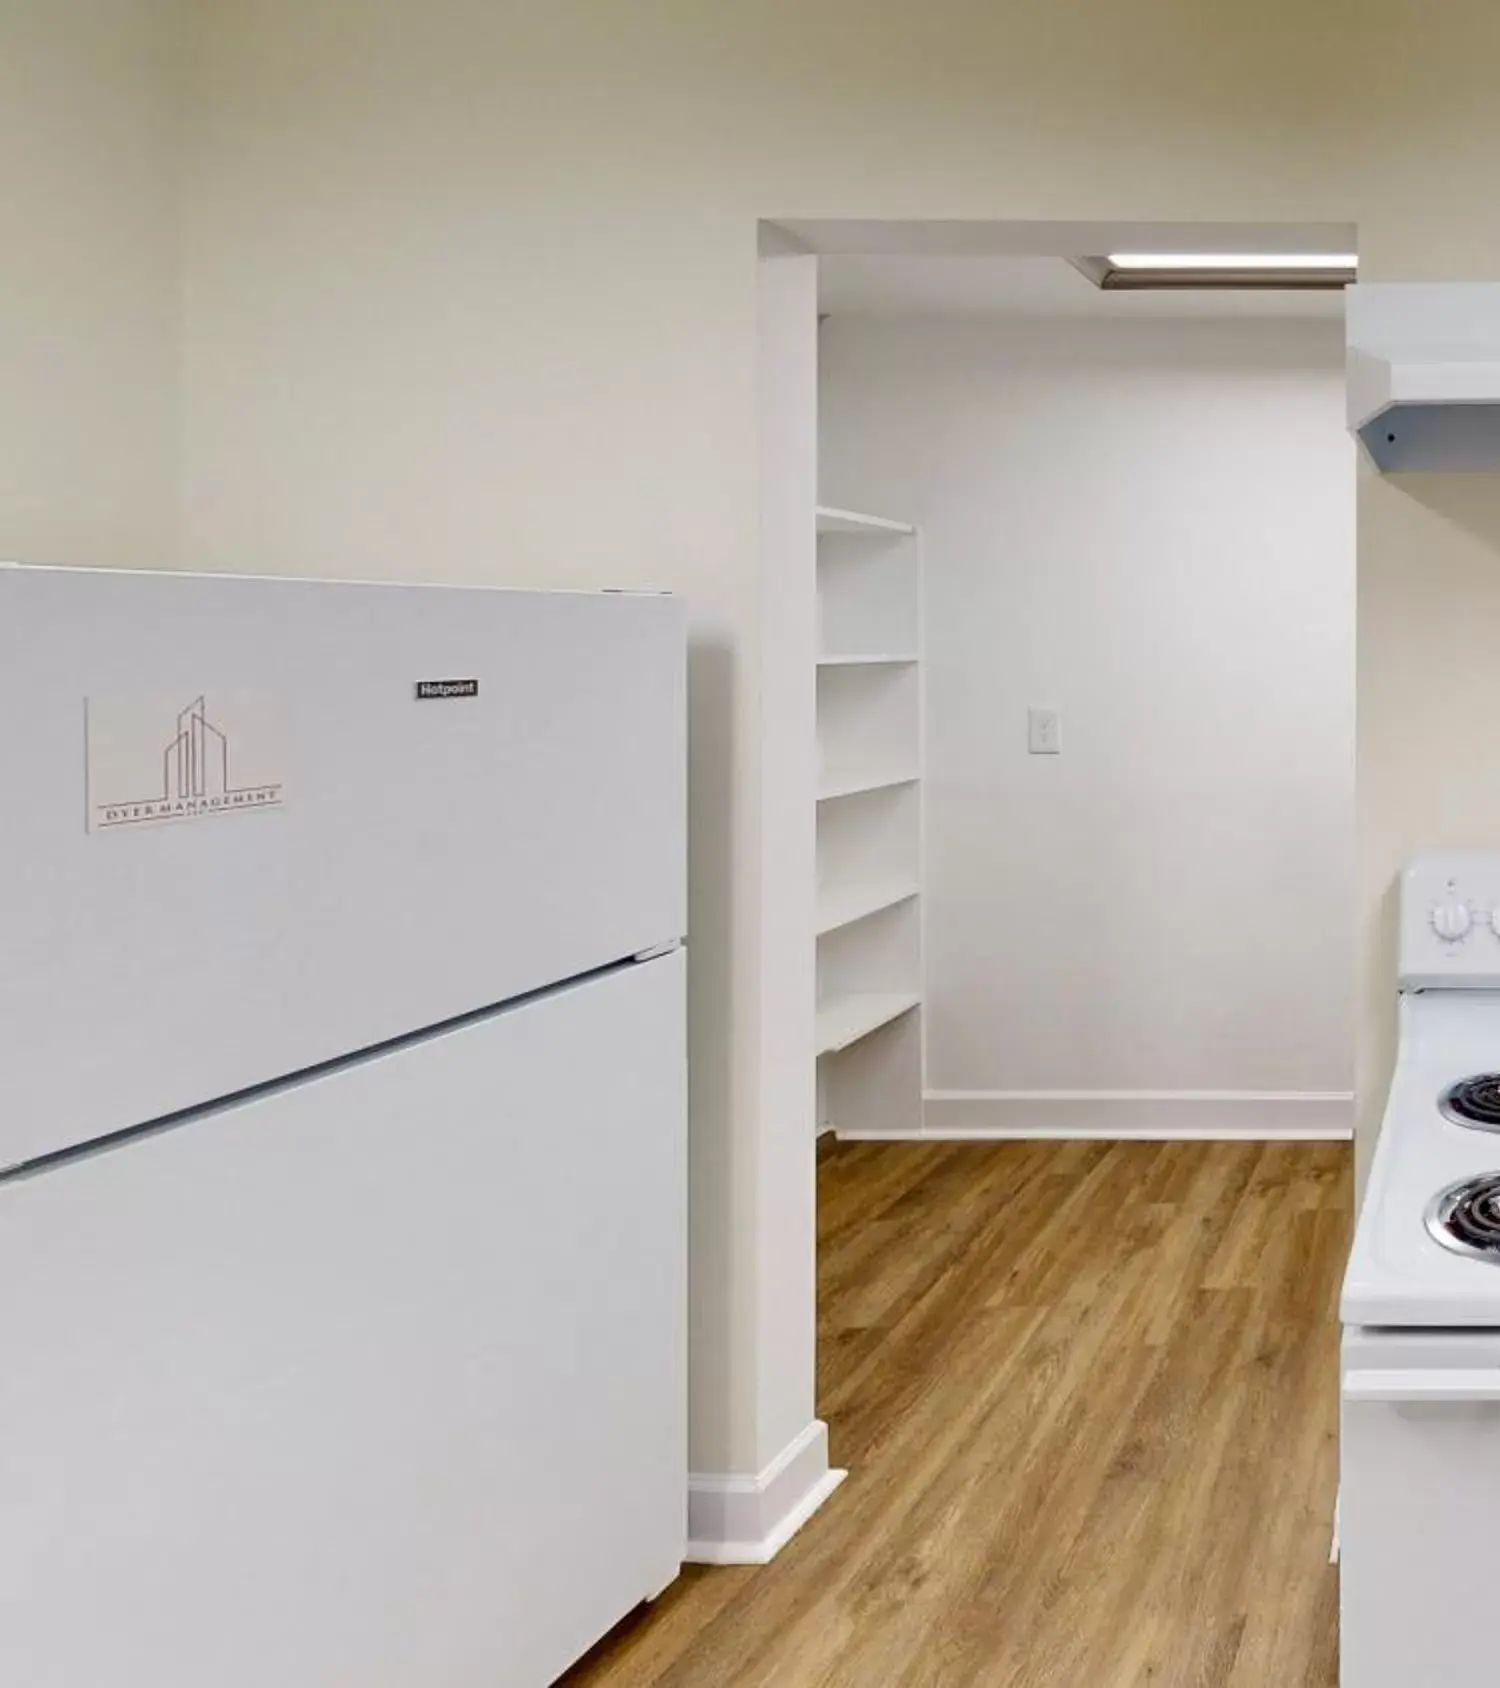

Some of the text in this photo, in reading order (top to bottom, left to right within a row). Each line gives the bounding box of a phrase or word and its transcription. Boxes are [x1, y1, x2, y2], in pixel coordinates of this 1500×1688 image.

[420, 681, 475, 697] Hotpoint
[106, 804, 153, 820] DYER
[160, 790, 276, 812] MANAGEMENT
